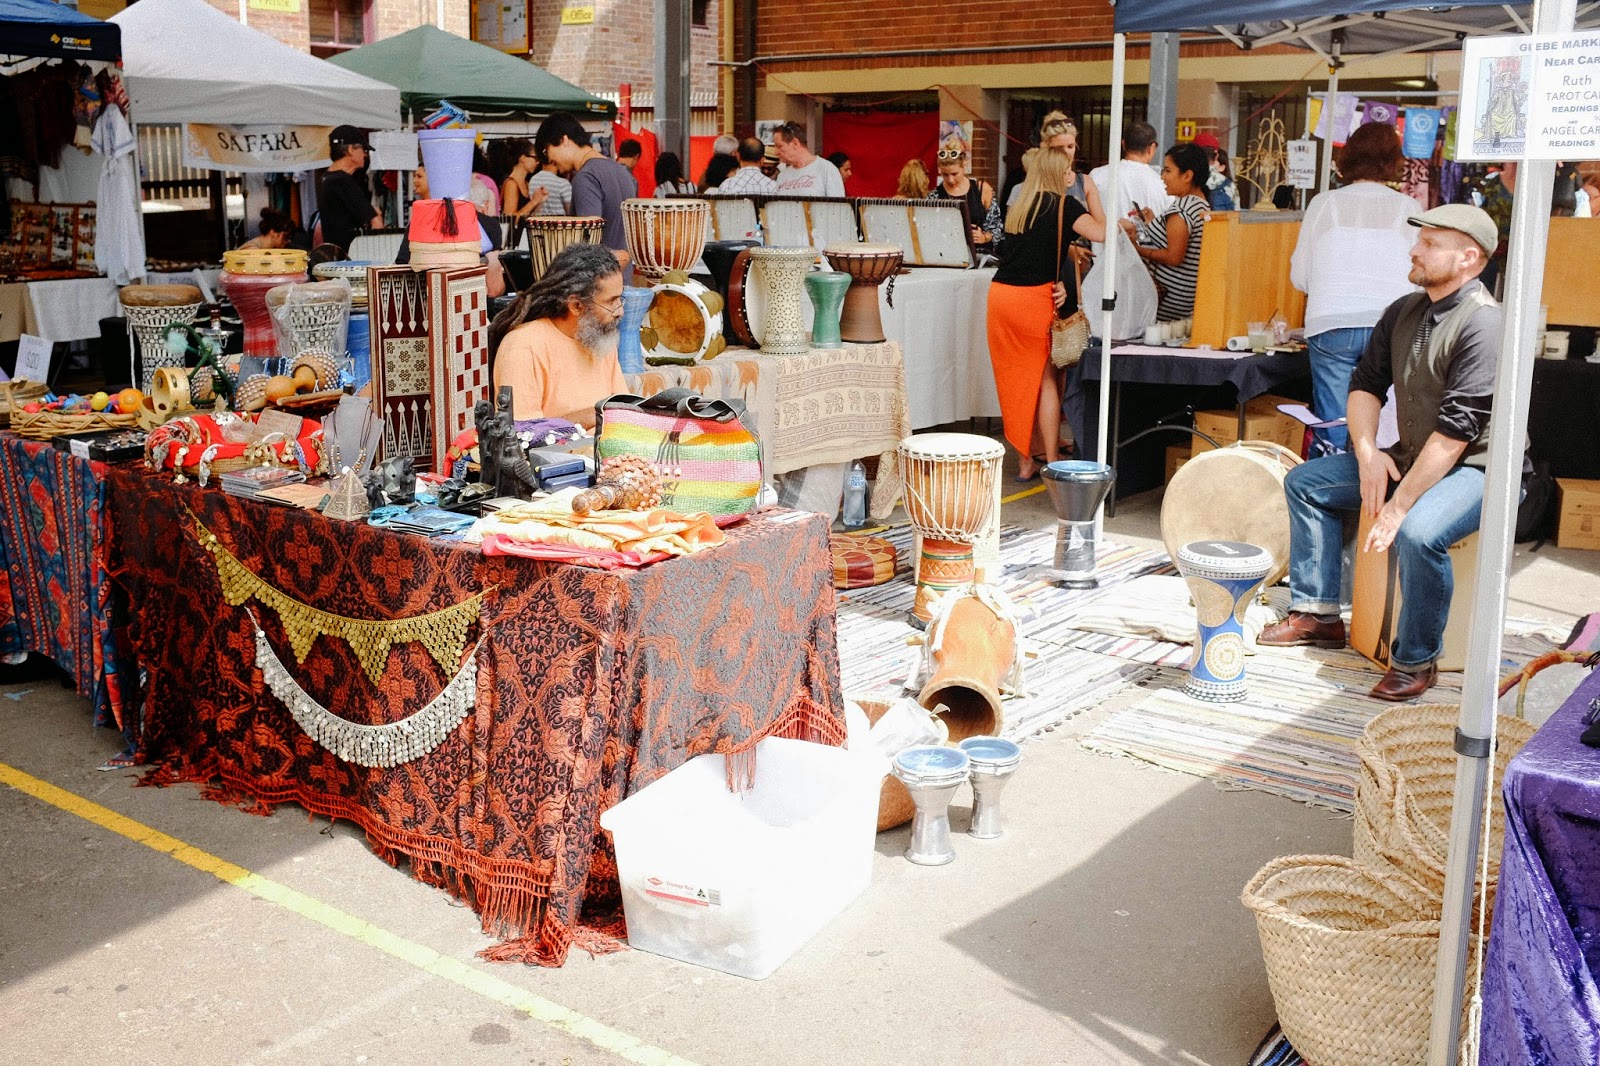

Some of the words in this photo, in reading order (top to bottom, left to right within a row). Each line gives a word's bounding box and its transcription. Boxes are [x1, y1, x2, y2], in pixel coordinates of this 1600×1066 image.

[1562, 38, 1600, 49] MARK
[1562, 74, 1592, 86] Ruth
[1546, 91, 1581, 101] TAROT
[1583, 90, 1600, 100] CA
[1551, 105, 1599, 113] READINGS
[1541, 126, 1577, 136] ANGEL
[217, 131, 302, 153] SAFARA
[1549, 139, 1596, 147] READINGS
